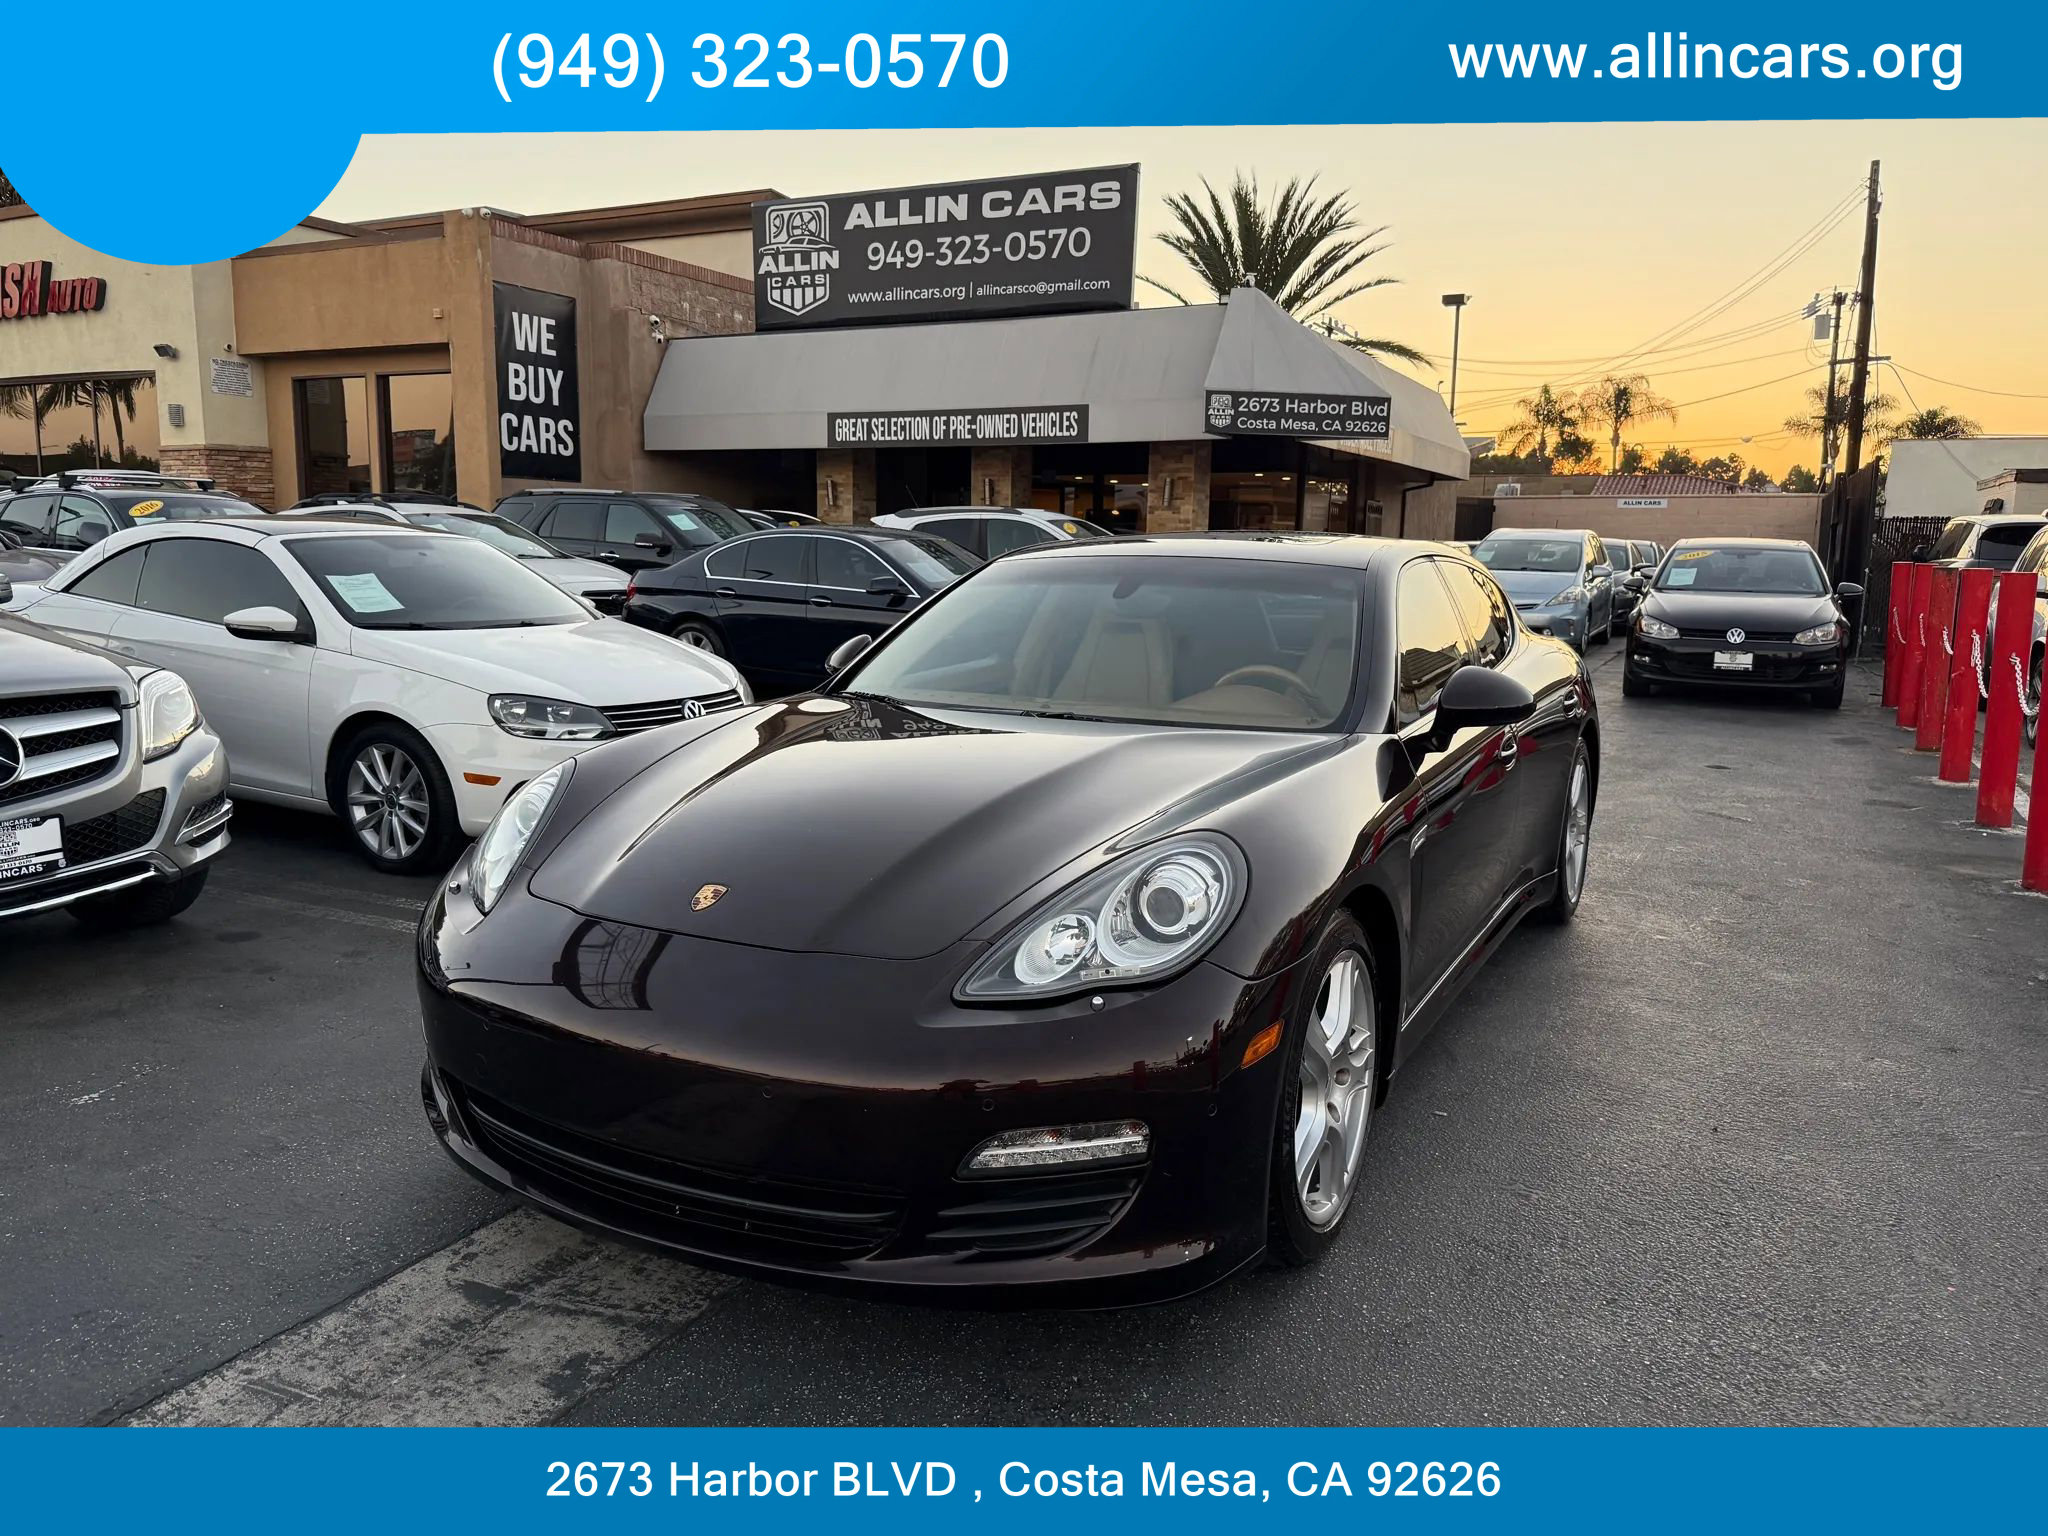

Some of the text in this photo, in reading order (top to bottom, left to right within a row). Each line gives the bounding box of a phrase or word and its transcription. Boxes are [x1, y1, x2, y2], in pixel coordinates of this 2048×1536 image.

[844, 180, 1121, 230] ALLIN CARS
[758, 250, 839, 275] ALLIN
[866, 226, 1092, 271] 949-323-0570
[0, 260, 102, 319] SH AUTO
[771, 274, 825, 288] CARS
[847, 278, 1111, 304] www.allincars.org allincarsco@gmail.com
[511, 311, 557, 357] WE
[508, 362, 564, 407] BUY
[1208, 408, 1235, 416] ALLIN
[1237, 397, 1388, 417] 2673 Harbor Blvd
[500, 412, 575, 457] CARS
[835, 411, 1079, 442] GREAT SELECTION OF PRE-OWNED VEHICLES
[1237, 417, 1387, 433] Costa Mesa, CA 92626
[134, 501, 159, 515] 2016
